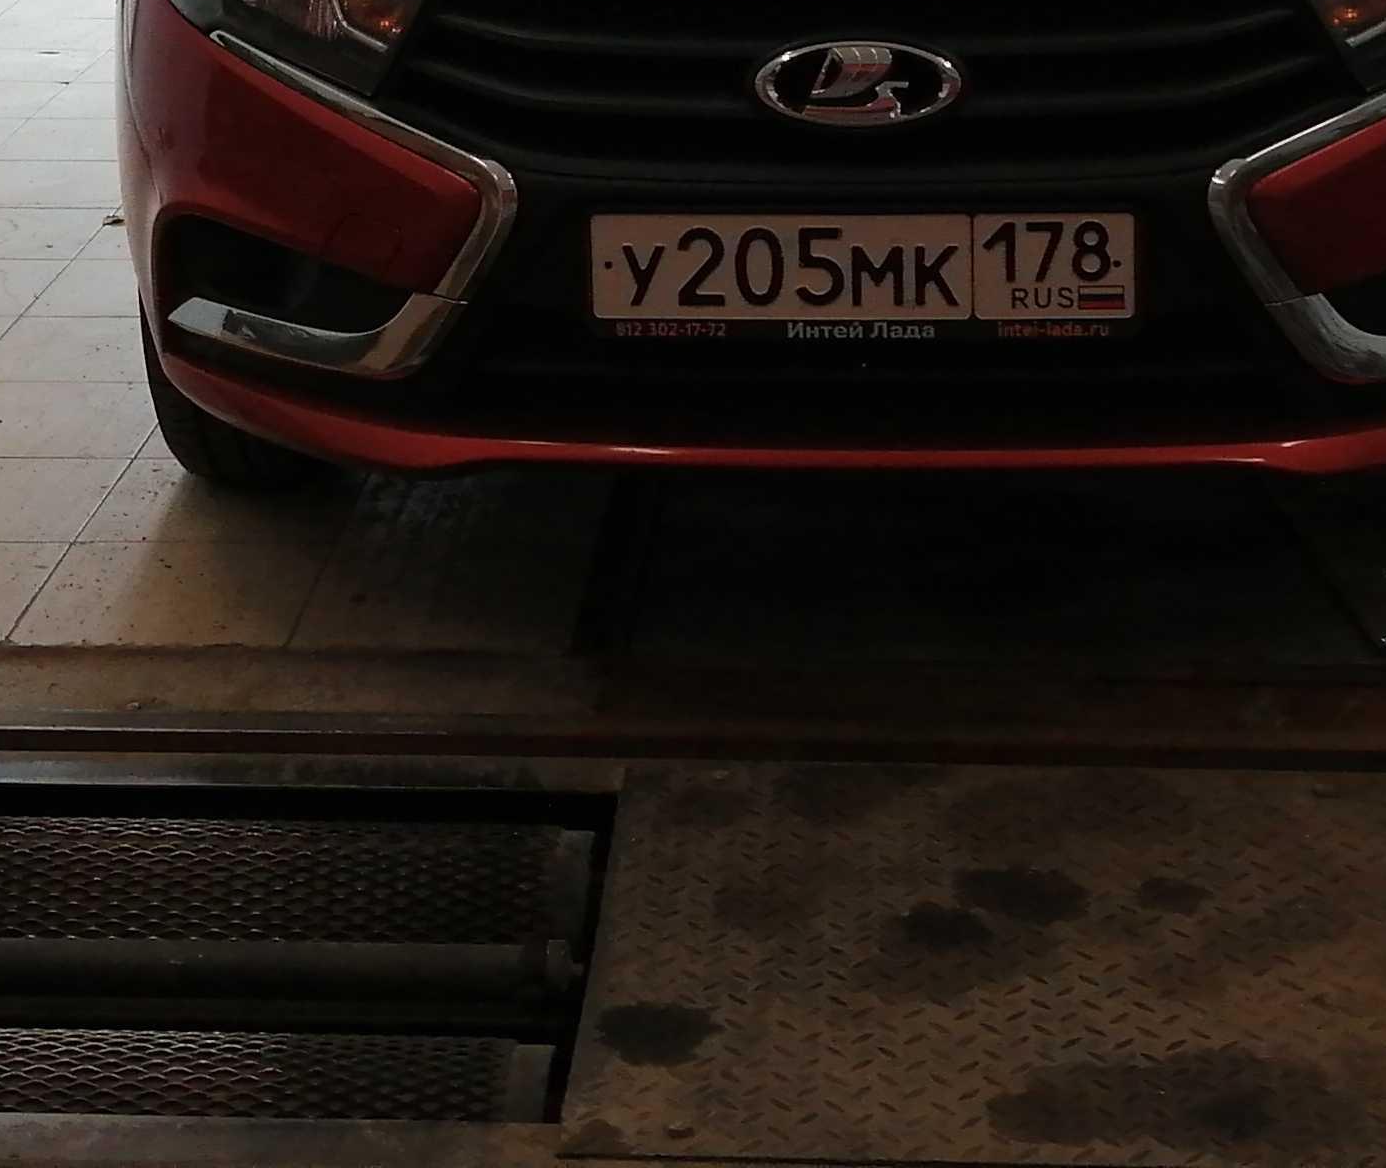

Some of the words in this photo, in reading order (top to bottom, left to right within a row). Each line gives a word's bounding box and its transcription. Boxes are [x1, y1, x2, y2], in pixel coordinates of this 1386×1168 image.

[982, 220, 1113, 283] 178
[1013, 287, 1075, 309] RUS
[787, 321, 863, 339] Интей
[869, 321, 936, 339] Лада
